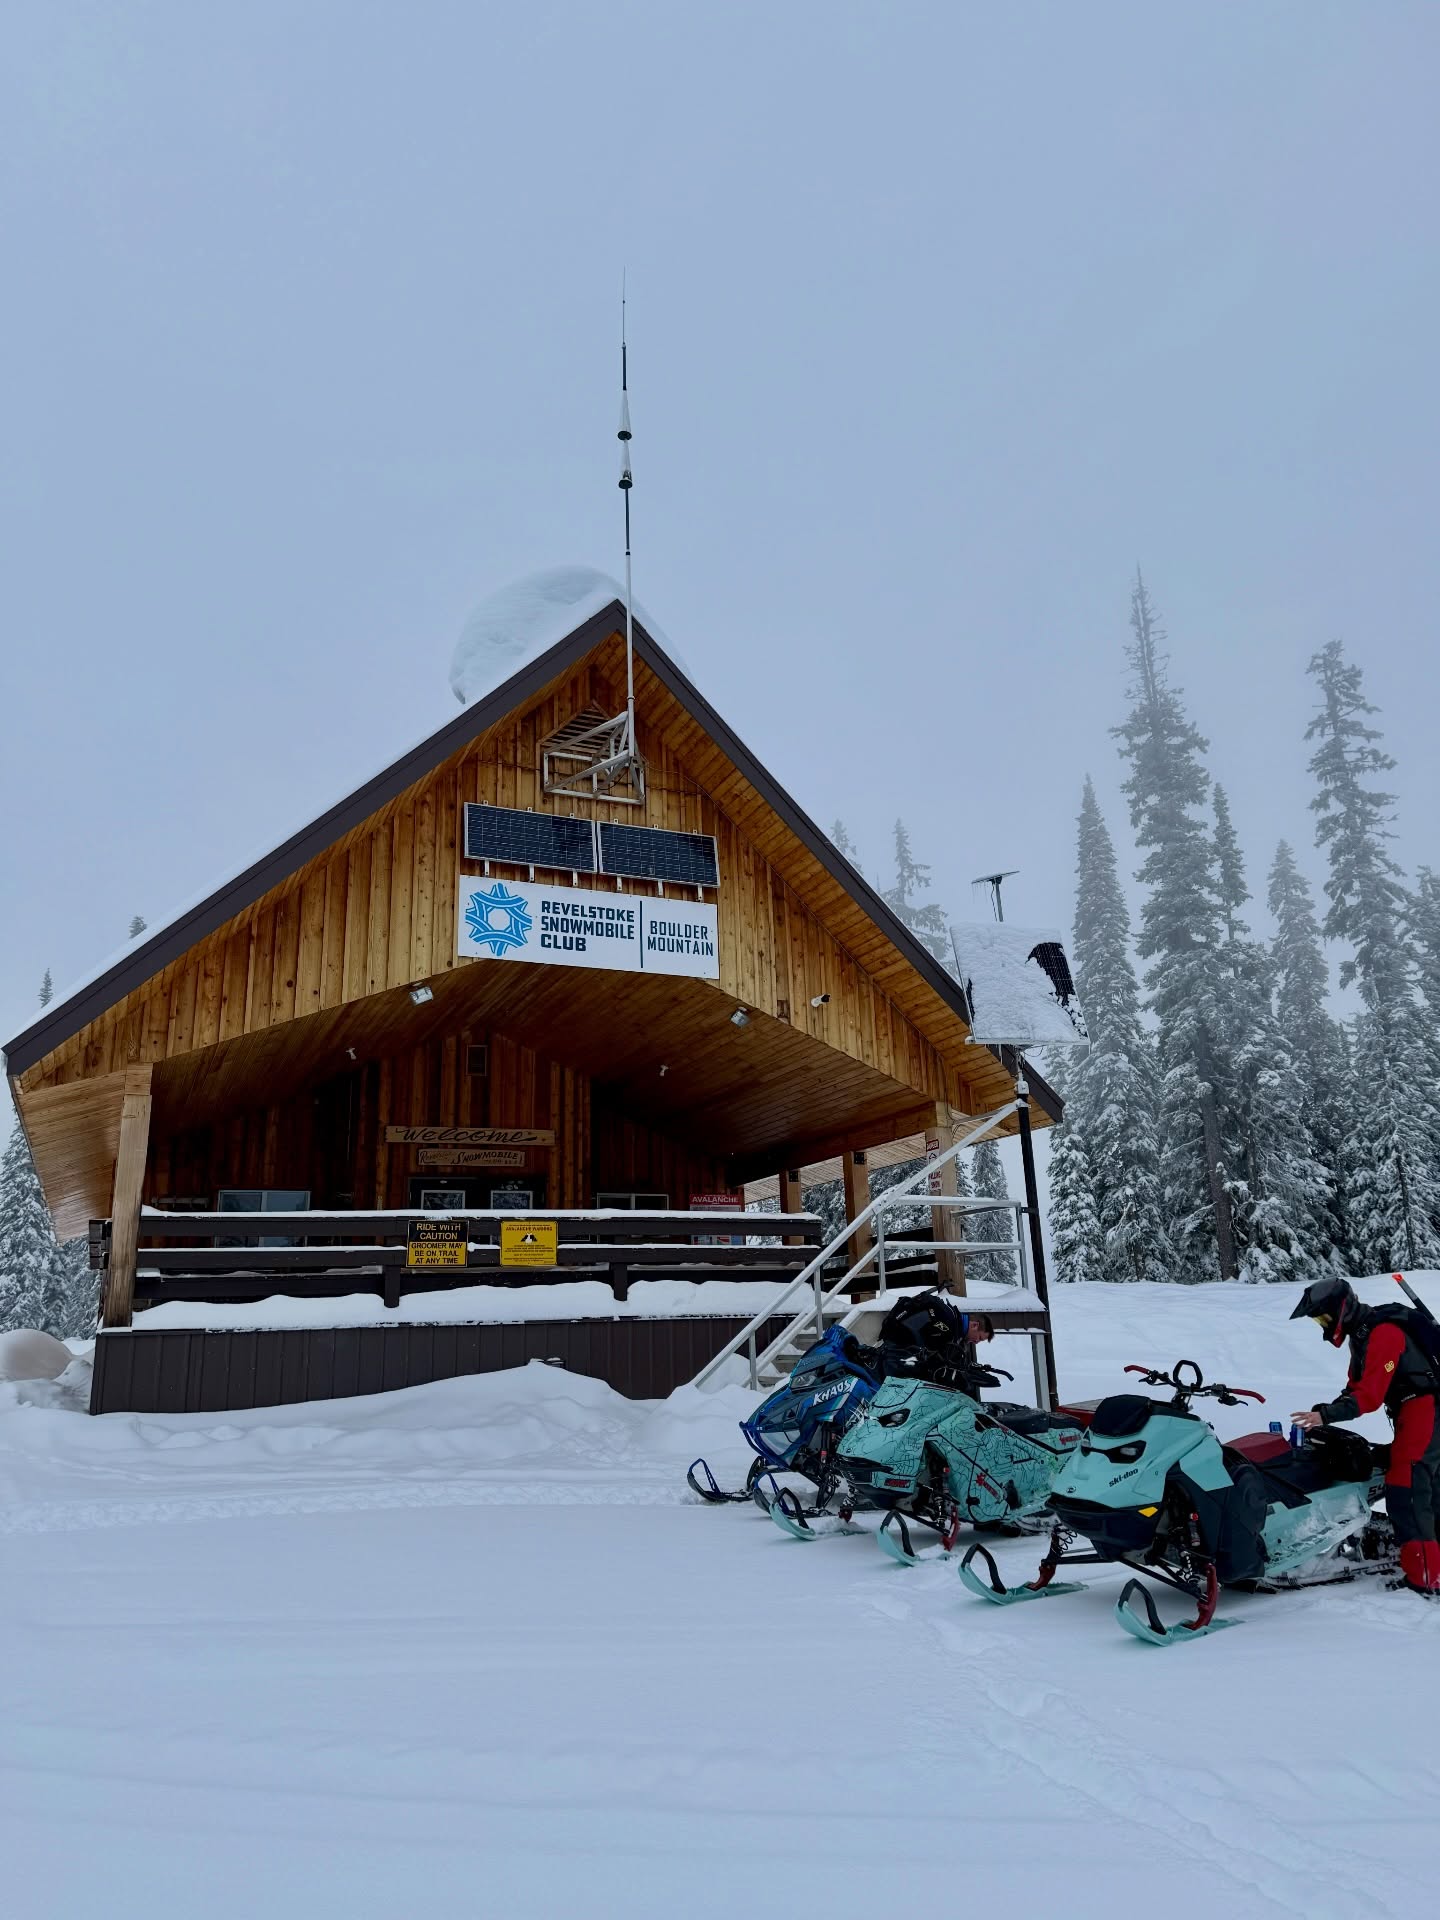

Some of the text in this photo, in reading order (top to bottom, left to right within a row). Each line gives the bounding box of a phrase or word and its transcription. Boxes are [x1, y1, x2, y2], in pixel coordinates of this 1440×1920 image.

[541, 900, 635, 922] REVELSTOKE
[541, 916, 635, 940] SNOWMOBILE
[650, 920, 708, 940] BOULDER
[540, 934, 587, 952] CLUB
[647, 935, 714, 957] MOUNTAIN
[416, 1223, 461, 1231] RIDE WITH
[419, 1232, 458, 1240] CAUTION
[812, 1380, 852, 1406] KHAOS
[1108, 1468, 1139, 1488] ski-doo
